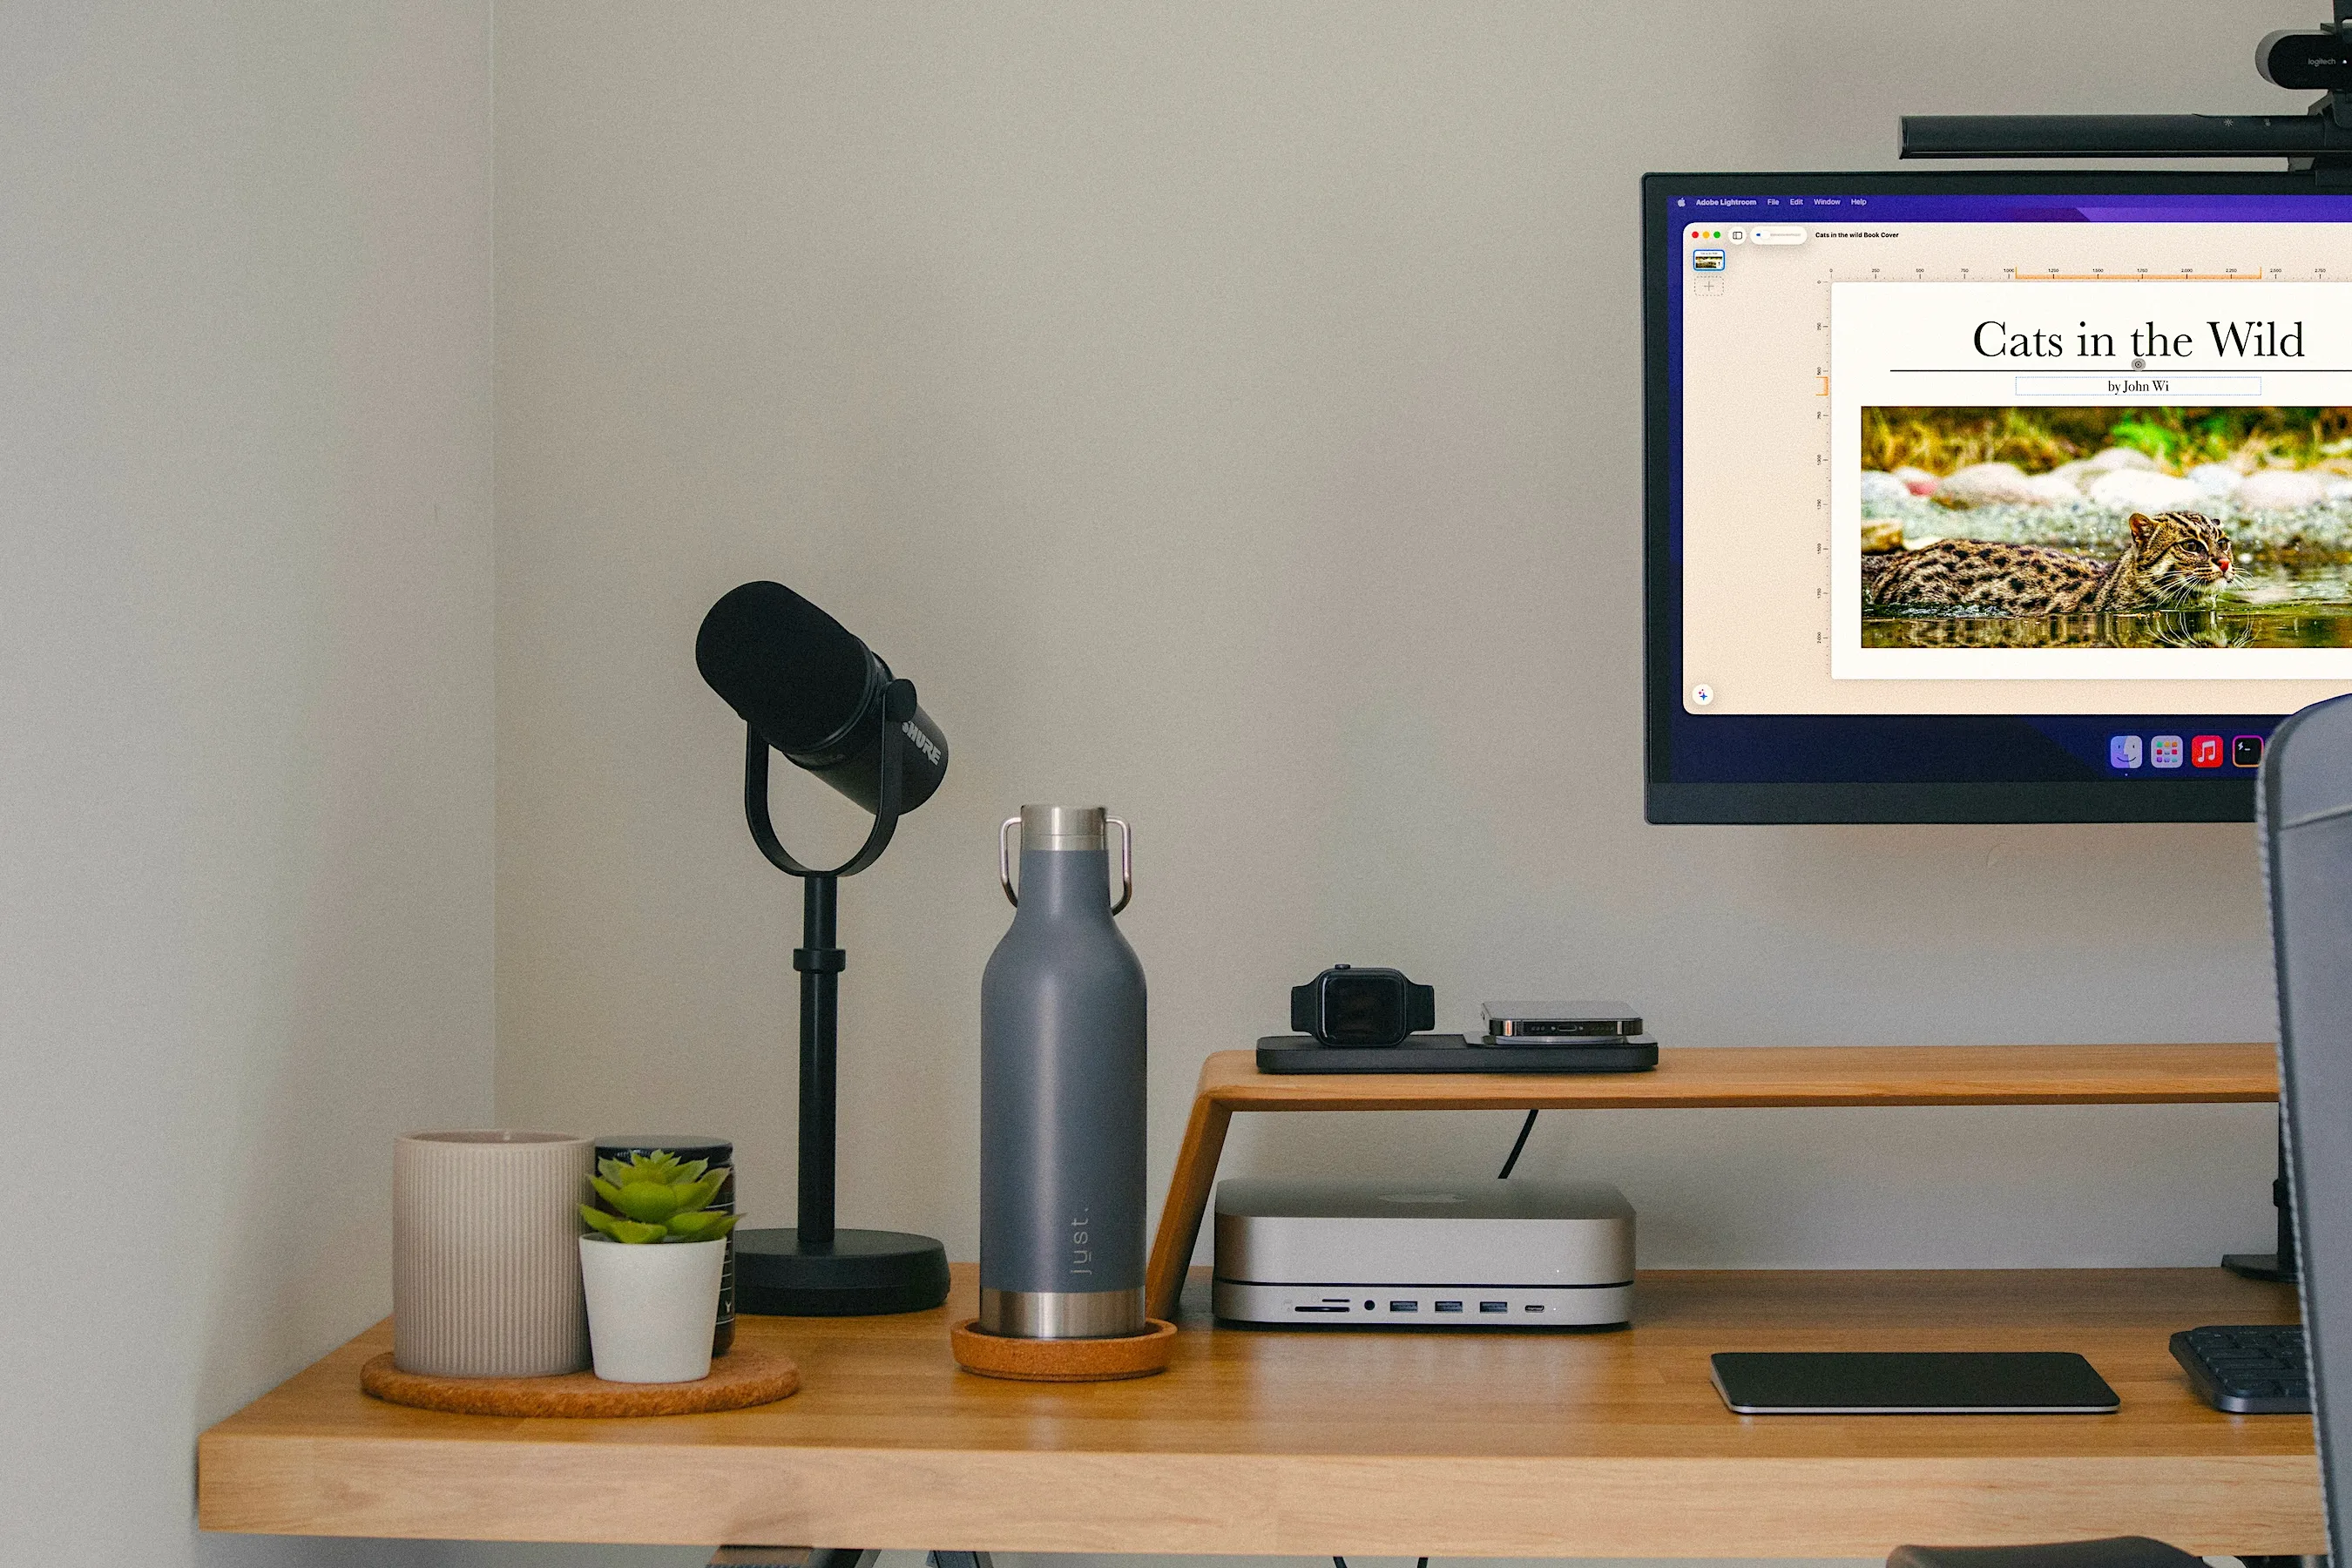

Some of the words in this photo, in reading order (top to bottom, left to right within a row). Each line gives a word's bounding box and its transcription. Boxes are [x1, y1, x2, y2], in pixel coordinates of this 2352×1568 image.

[2308, 58, 2336, 67] logitech
[1720, 199, 1757, 207] Lightroom
[1974, 321, 2063, 357] Cats
[2077, 321, 2116, 357] in
[2131, 321, 2193, 357] the
[2207, 321, 2306, 357] Wild
[2108, 380, 2120, 395] by
[2123, 380, 2149, 393] John
[2152, 380, 2170, 392] Wi
